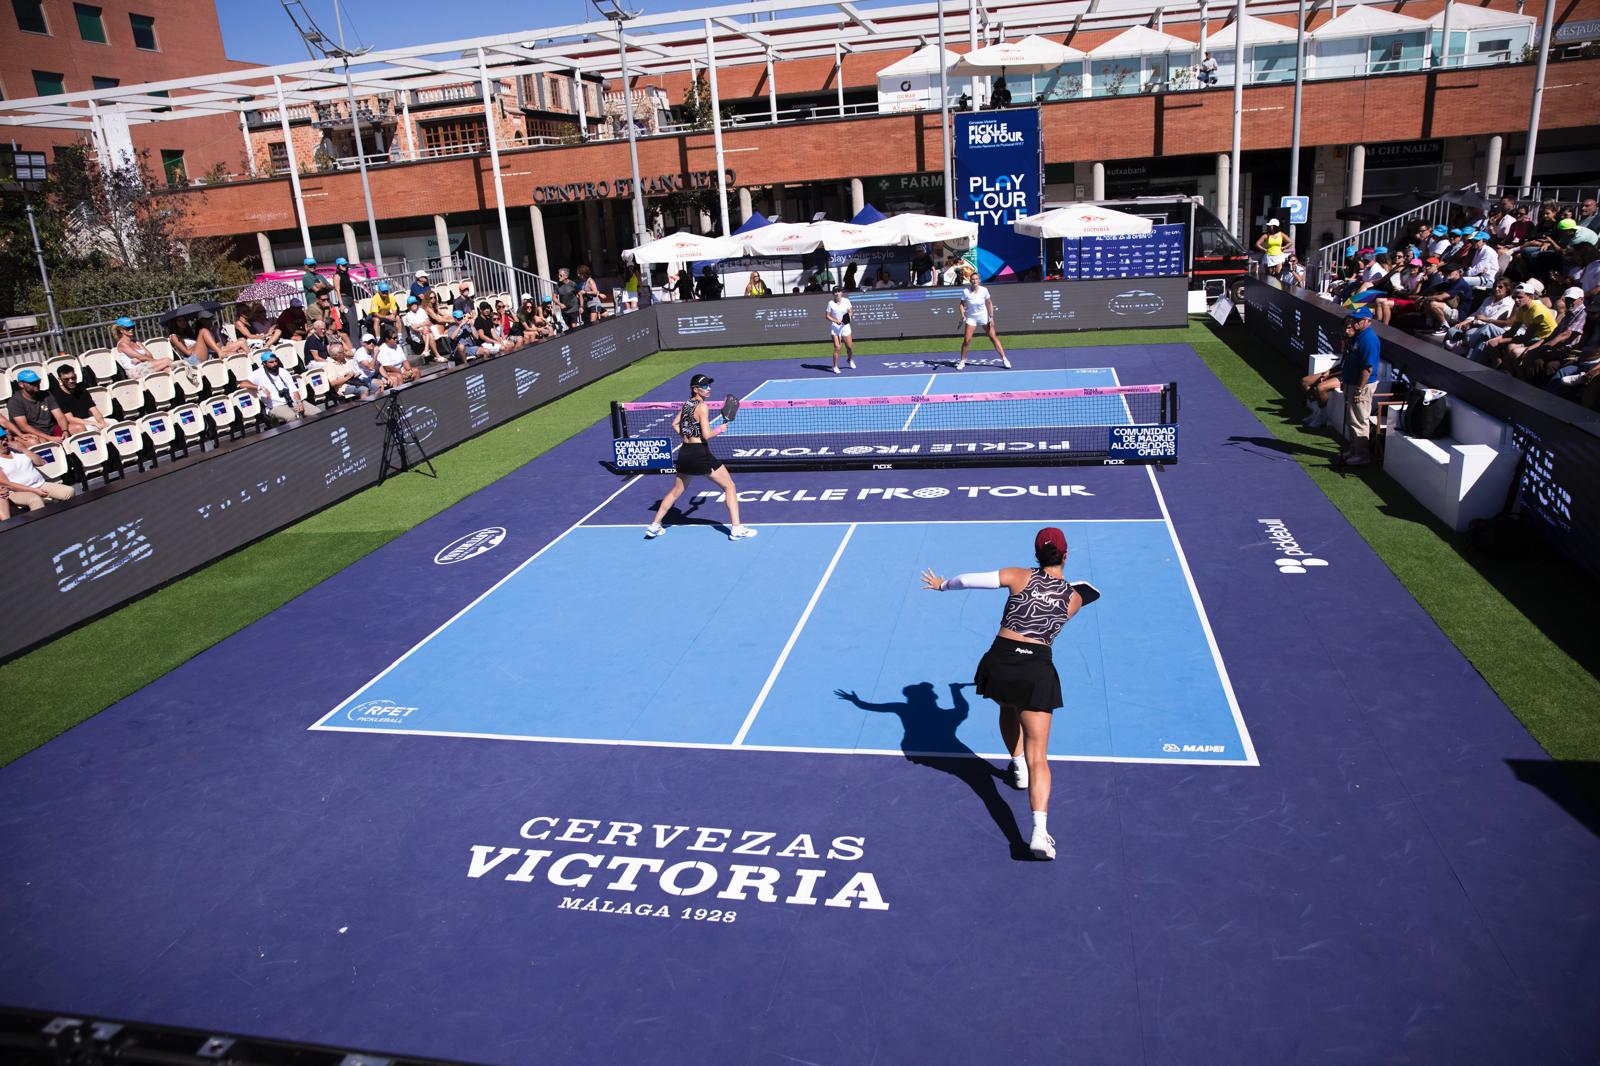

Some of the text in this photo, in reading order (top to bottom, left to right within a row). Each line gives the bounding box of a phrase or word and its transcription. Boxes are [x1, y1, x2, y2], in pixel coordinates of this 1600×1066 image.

[968, 123, 1008, 135] PICKLE
[1106, 166, 1147, 176] kutxabank
[900, 174, 943, 189] FARM
[969, 173, 1025, 193] PLAY
[532, 181, 610, 203] CENTRO
[969, 191, 1027, 210] YOUR
[1113, 427, 1176, 436] COMUNIDAD
[614, 439, 667, 448] COMUNIDAD
[1122, 434, 1176, 443] DE MADRID
[615, 446, 660, 455] DE MADRID
[1137, 448, 1164, 456] OPEN
[856, 486, 951, 501] PRO
[958, 484, 1097, 498] TOUR
[364, 705, 419, 717] RFET
[1182, 744, 1225, 753] MAPEI
[518, 815, 866, 862] CERVEZAS
[466, 844, 891, 911] VICTORIA
[557, 896, 738, 924] MÁLAGA 1928
